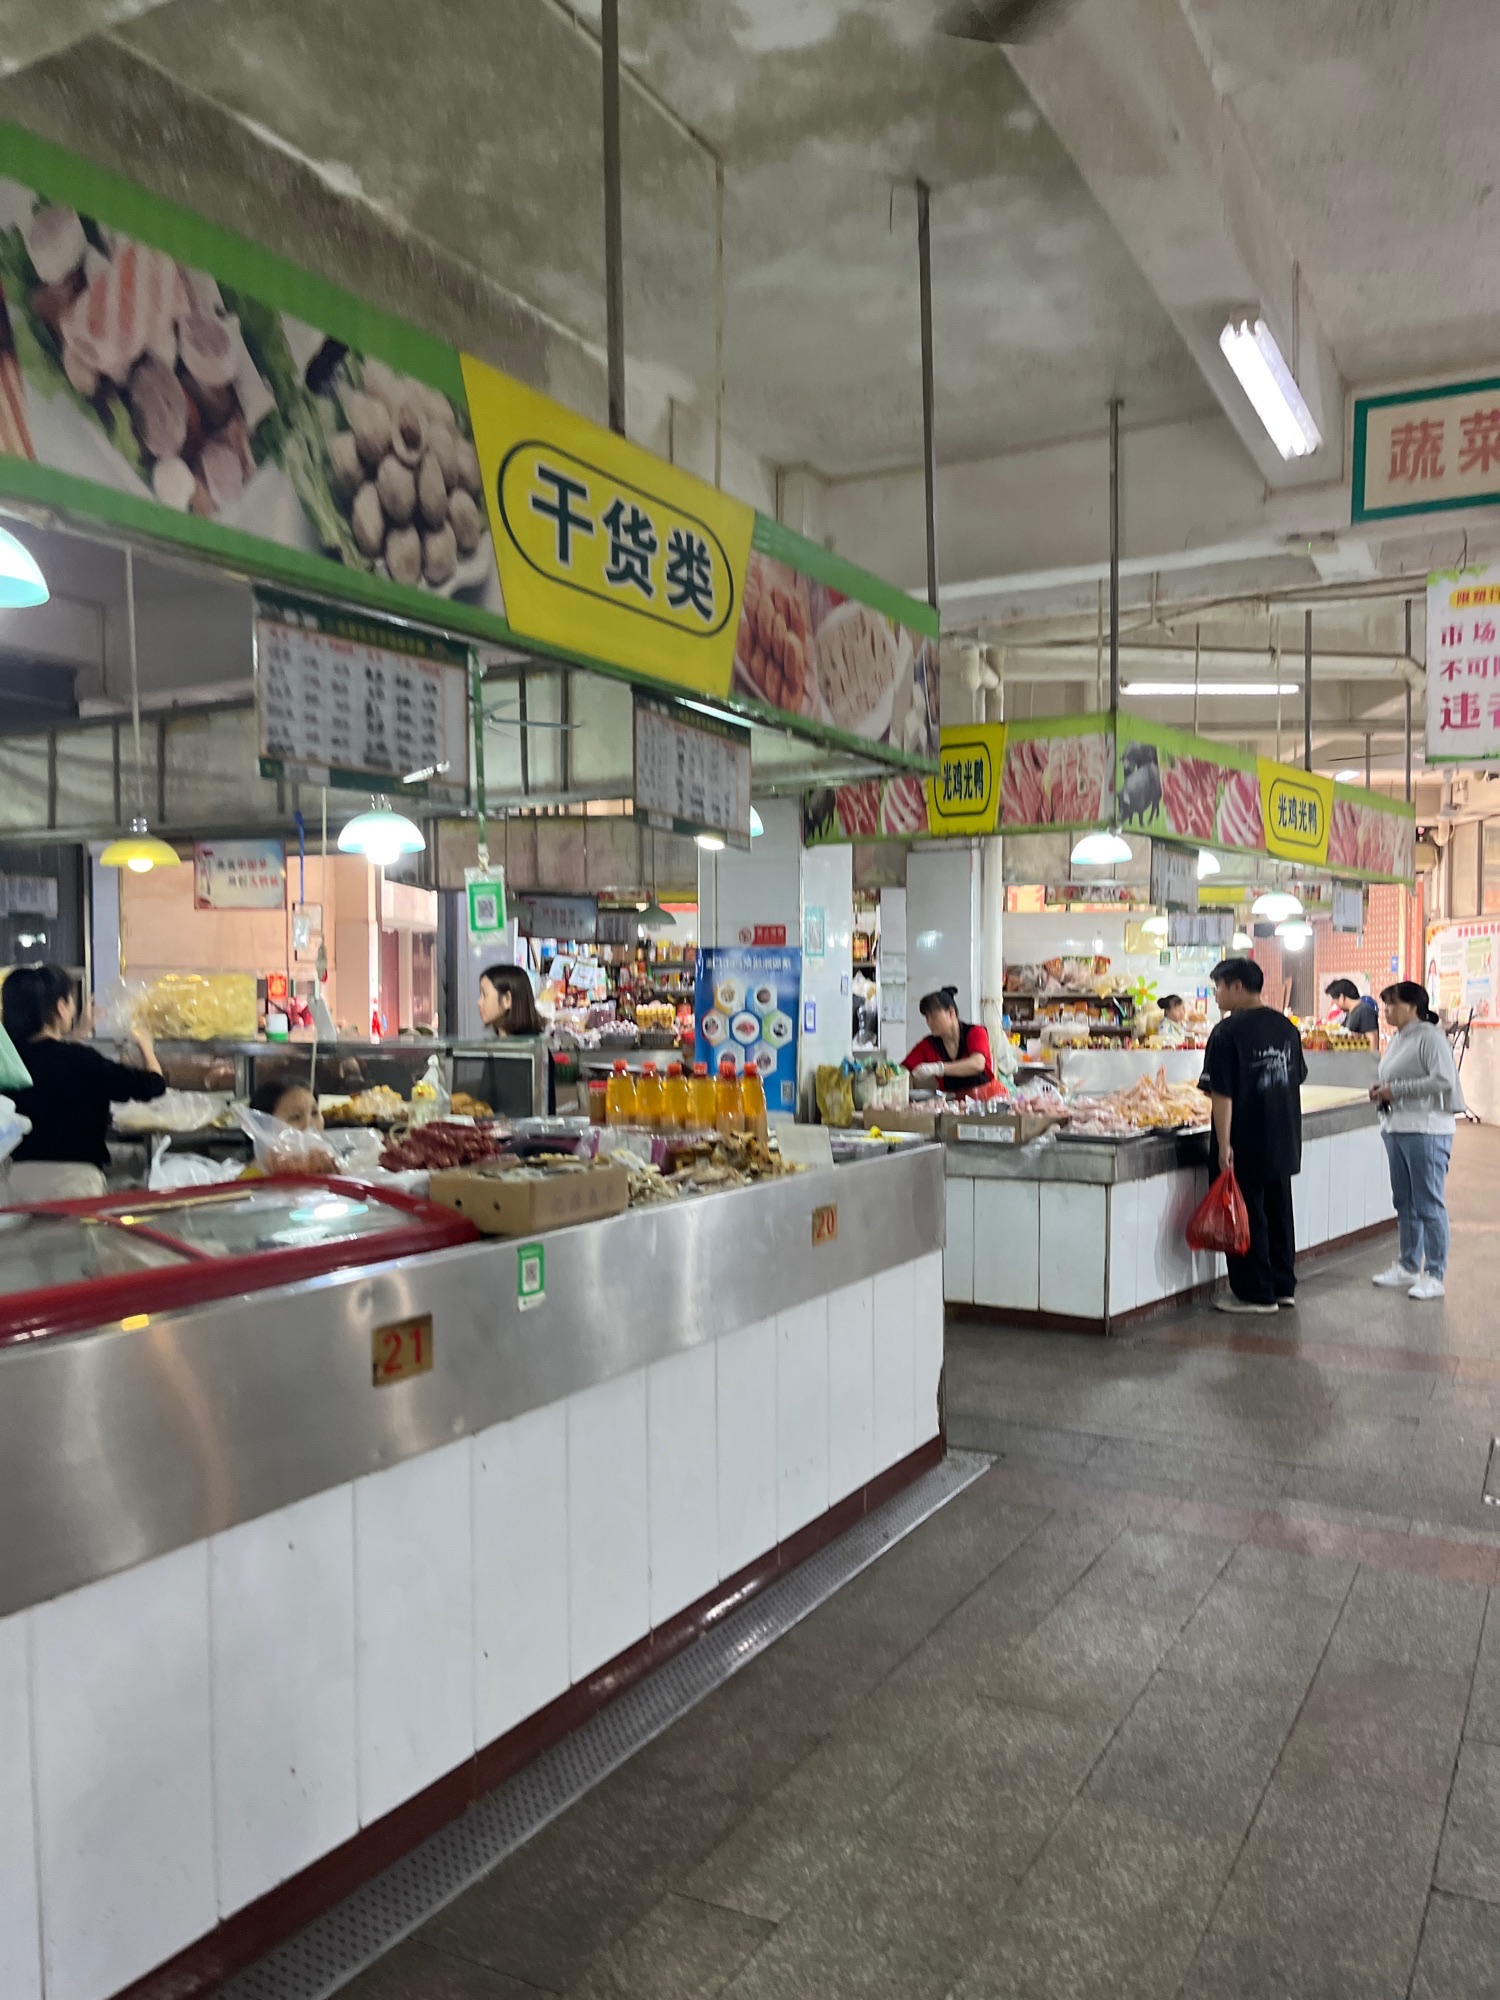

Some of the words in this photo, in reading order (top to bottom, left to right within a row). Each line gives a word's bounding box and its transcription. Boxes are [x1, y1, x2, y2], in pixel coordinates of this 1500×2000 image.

[1388, 410, 1500, 481] 蔬菜
[531, 464, 713, 622] 干货类
[1441, 621, 1496, 646] 市场
[1440, 652, 1500, 681] 不可
[943, 758, 983, 801] 光鸡光鸭
[1278, 793, 1317, 836] 光鸡光鸭
[815, 1208, 835, 1238] 20
[382, 1324, 422, 1374] 21
